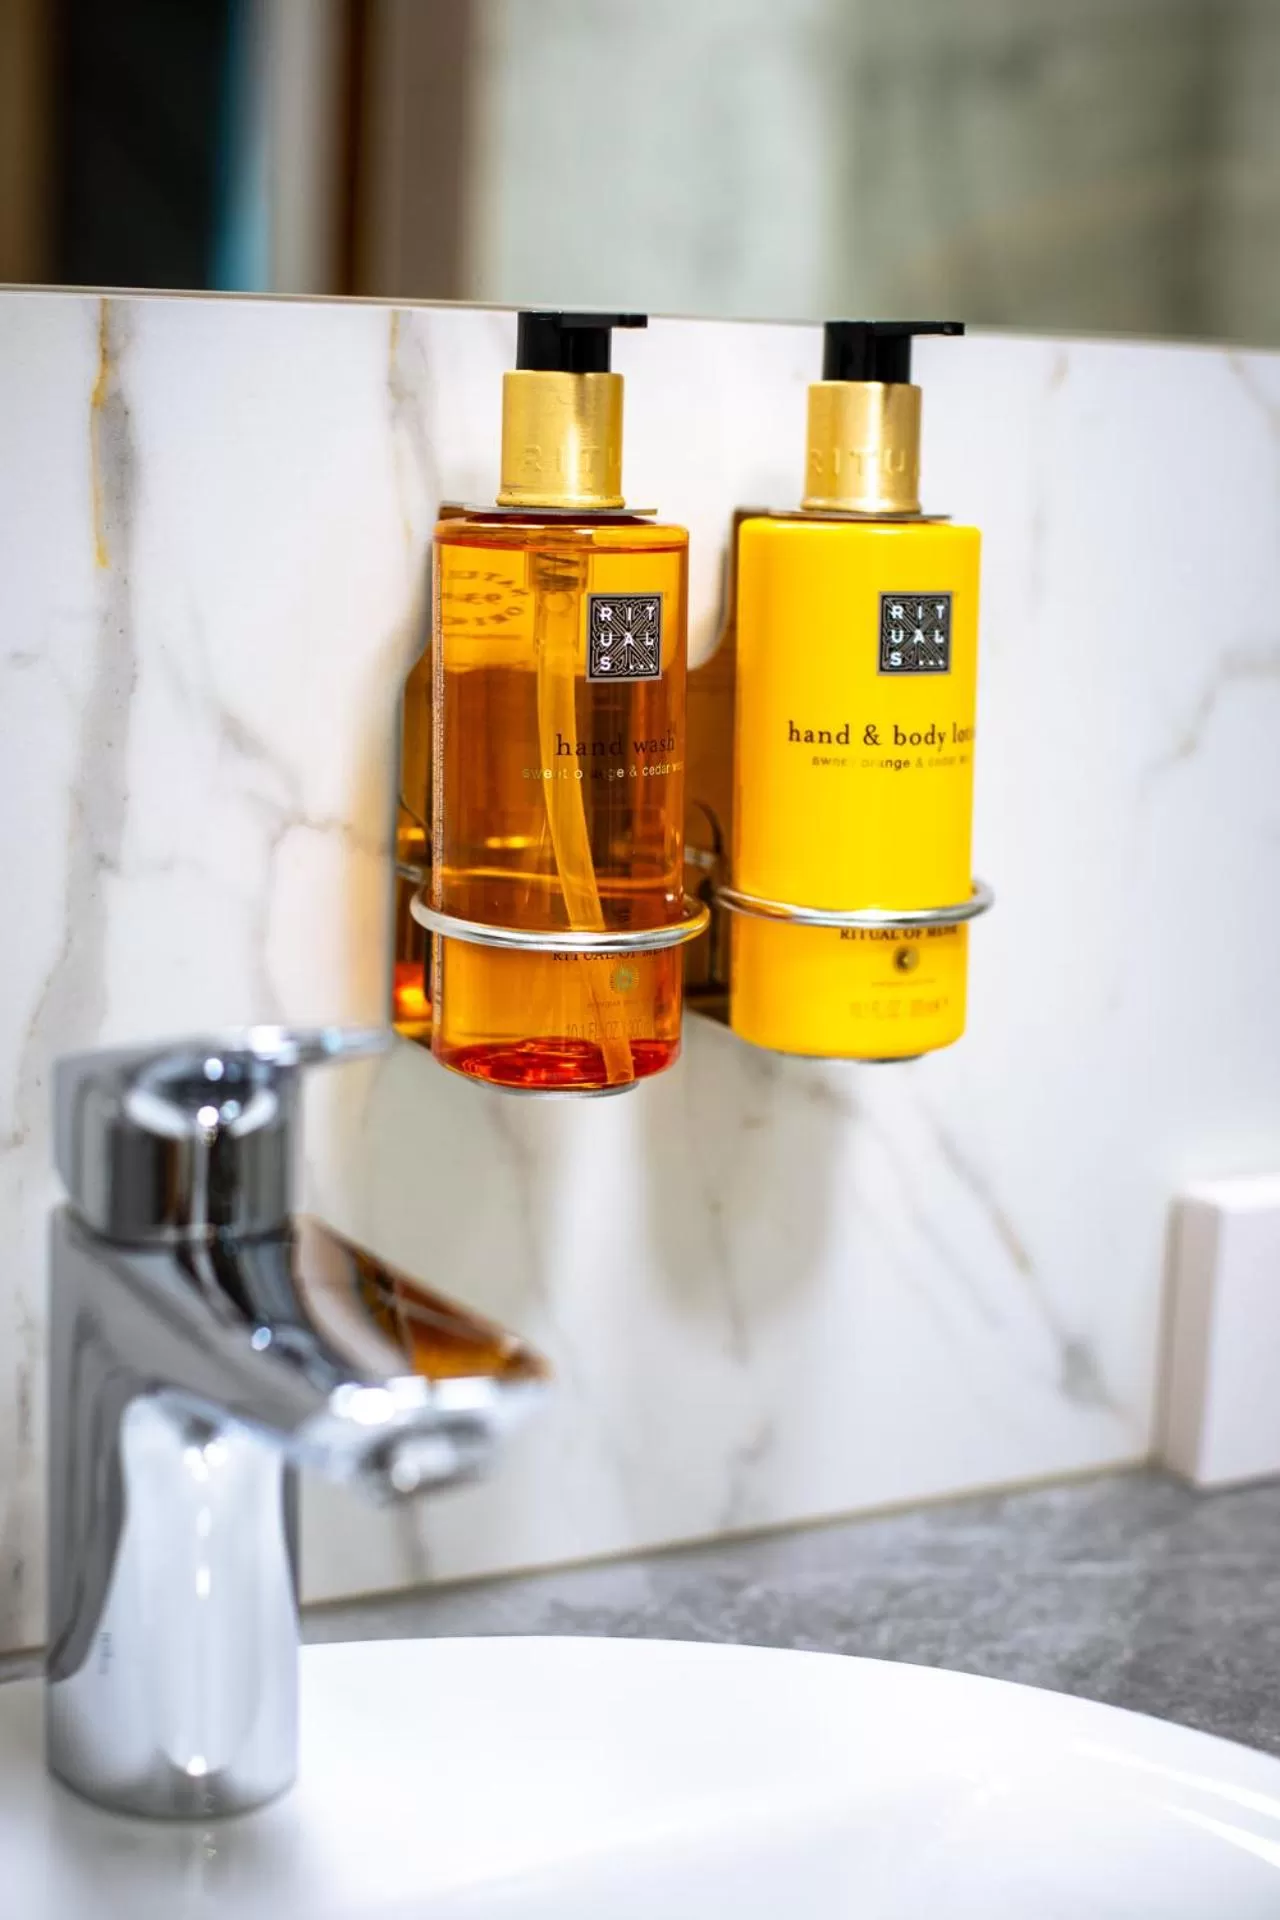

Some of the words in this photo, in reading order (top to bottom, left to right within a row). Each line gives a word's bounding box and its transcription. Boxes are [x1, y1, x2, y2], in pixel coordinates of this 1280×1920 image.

[555, 732, 624, 756] hand
[633, 729, 675, 753] wash
[787, 719, 851, 745] hand
[863, 723, 881, 746] &
[893, 723, 947, 752] body
